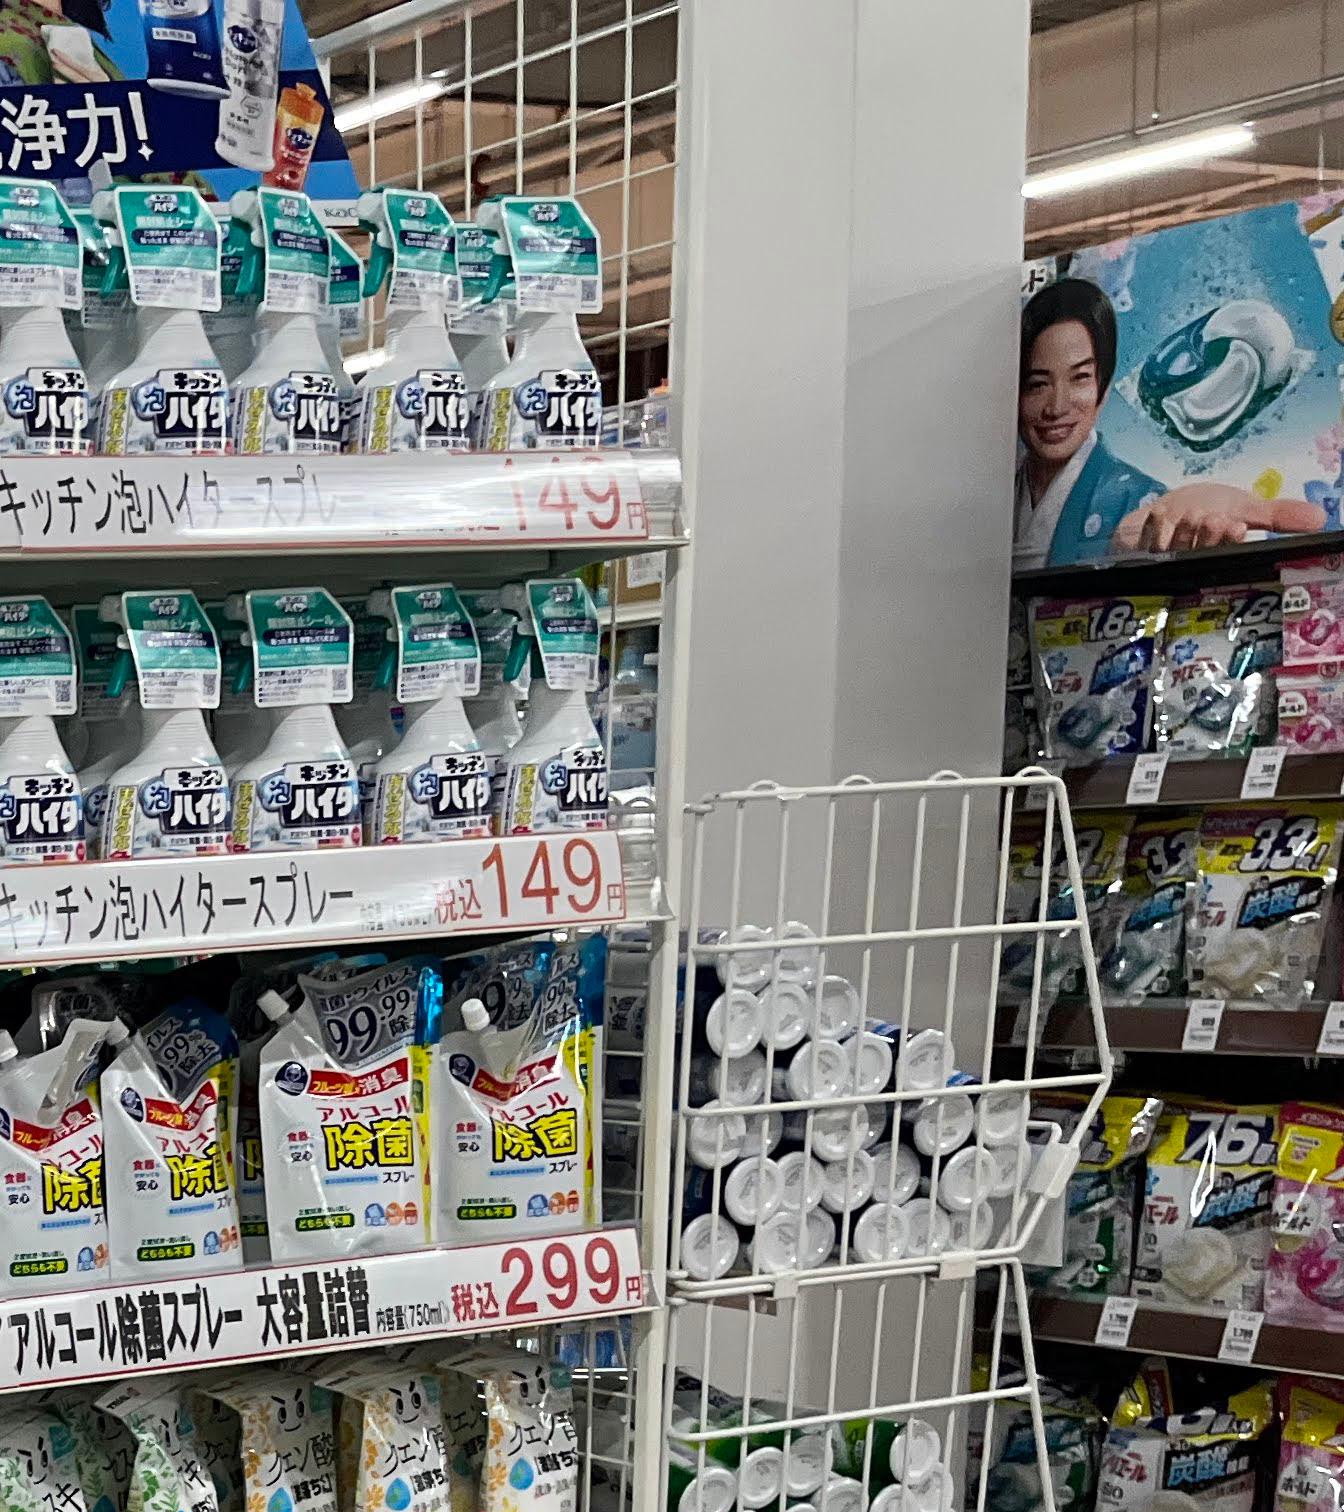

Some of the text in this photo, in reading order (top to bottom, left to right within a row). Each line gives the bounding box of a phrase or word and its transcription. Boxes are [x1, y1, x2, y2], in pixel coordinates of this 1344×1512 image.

[322, 1115, 414, 1171] 除菌
[492, 1109, 578, 1164] 除菌
[1178, 1112, 1268, 1165] 76
[14, 1282, 245, 1376] アルコール除菌スプレー
[450, 1282, 501, 1323] 税込
